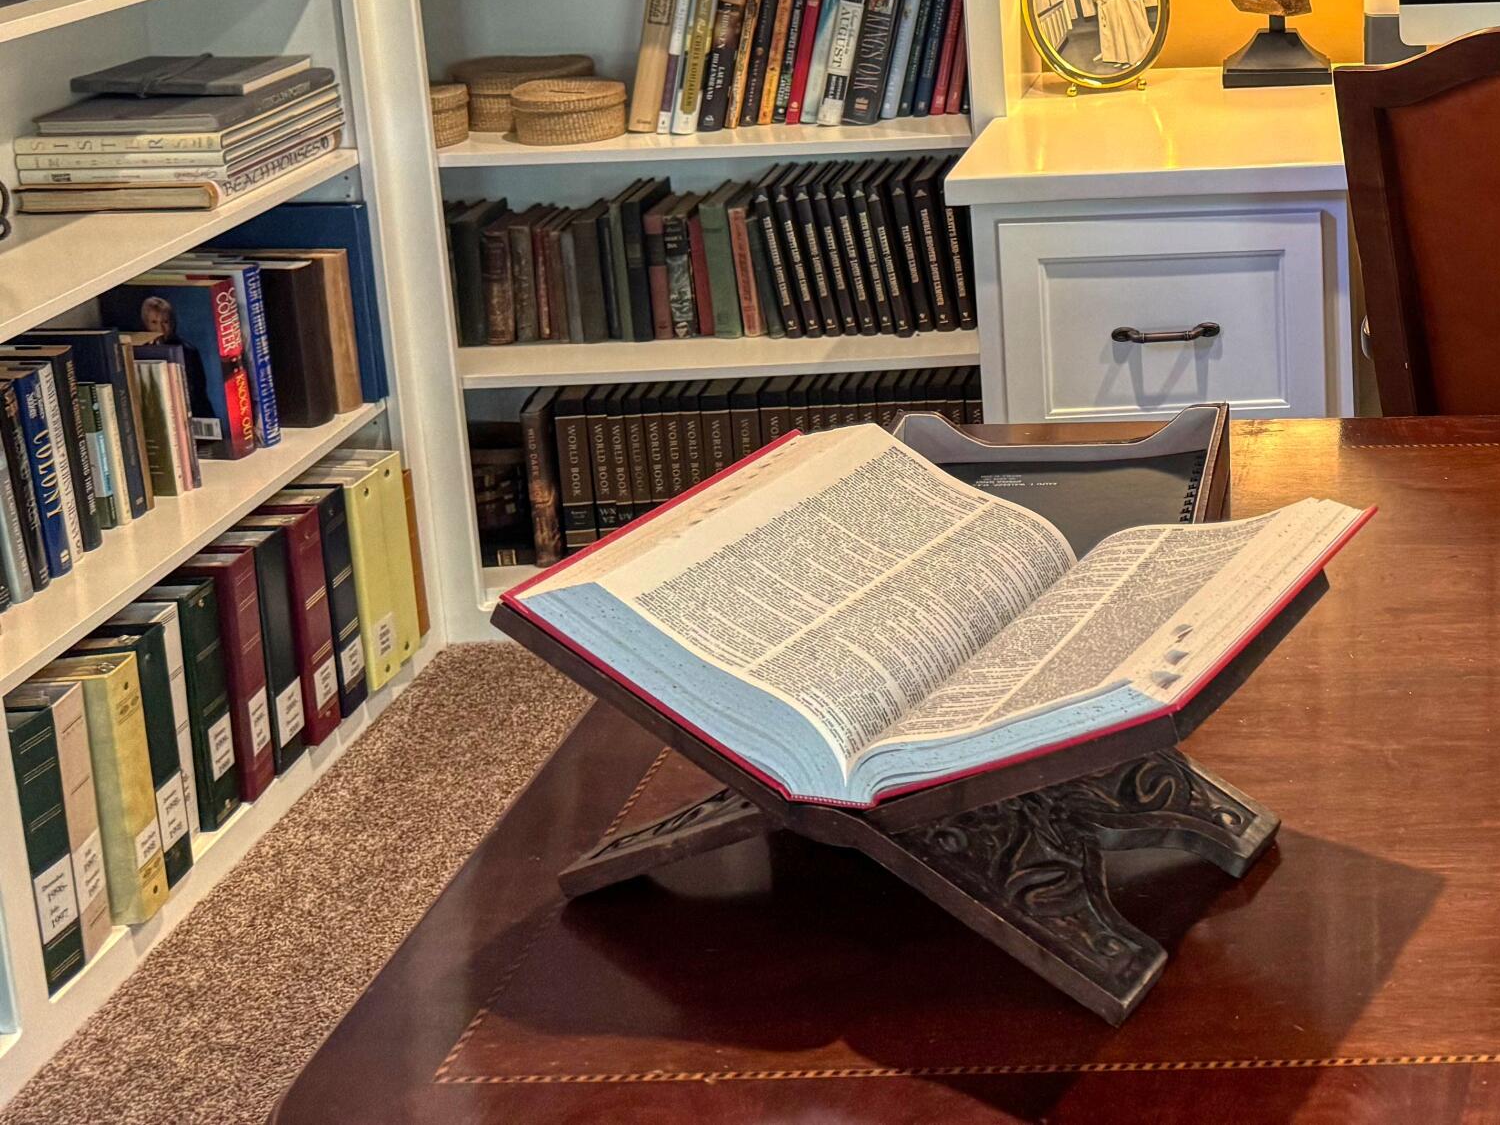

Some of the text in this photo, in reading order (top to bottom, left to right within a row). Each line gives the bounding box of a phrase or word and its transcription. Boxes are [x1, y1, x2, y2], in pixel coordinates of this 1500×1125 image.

[831, 7, 851, 68] AUGUST
[853, 14, 890, 93] KING'S OAK
[221, 138, 321, 196] BEACH HOUSES
[901, 225, 911, 242] FLINT
[920, 208, 933, 235] TROUBLE
[215, 290, 238, 353] COULTER
[235, 373, 254, 442] KNOCK OUT
[79, 440, 91, 475] CHASING
[527, 428, 539, 475] WILD DARK
[566, 424, 580, 496] WORLD BOOK
[594, 424, 609, 494] WORLD BOOK
[612, 424, 626, 495] WORLD BOOK
[629, 423, 640, 462] WORLD
[648, 421, 663, 493] WORLD BOOK
[667, 420, 681, 492] WORLD BOOK
[686, 420, 697, 458] WORLD
[711, 419, 721, 458] WORLD
[32, 429, 63, 520] COLONY
[84, 476, 93, 493] THE
[87, 494, 97, 514] DIME
